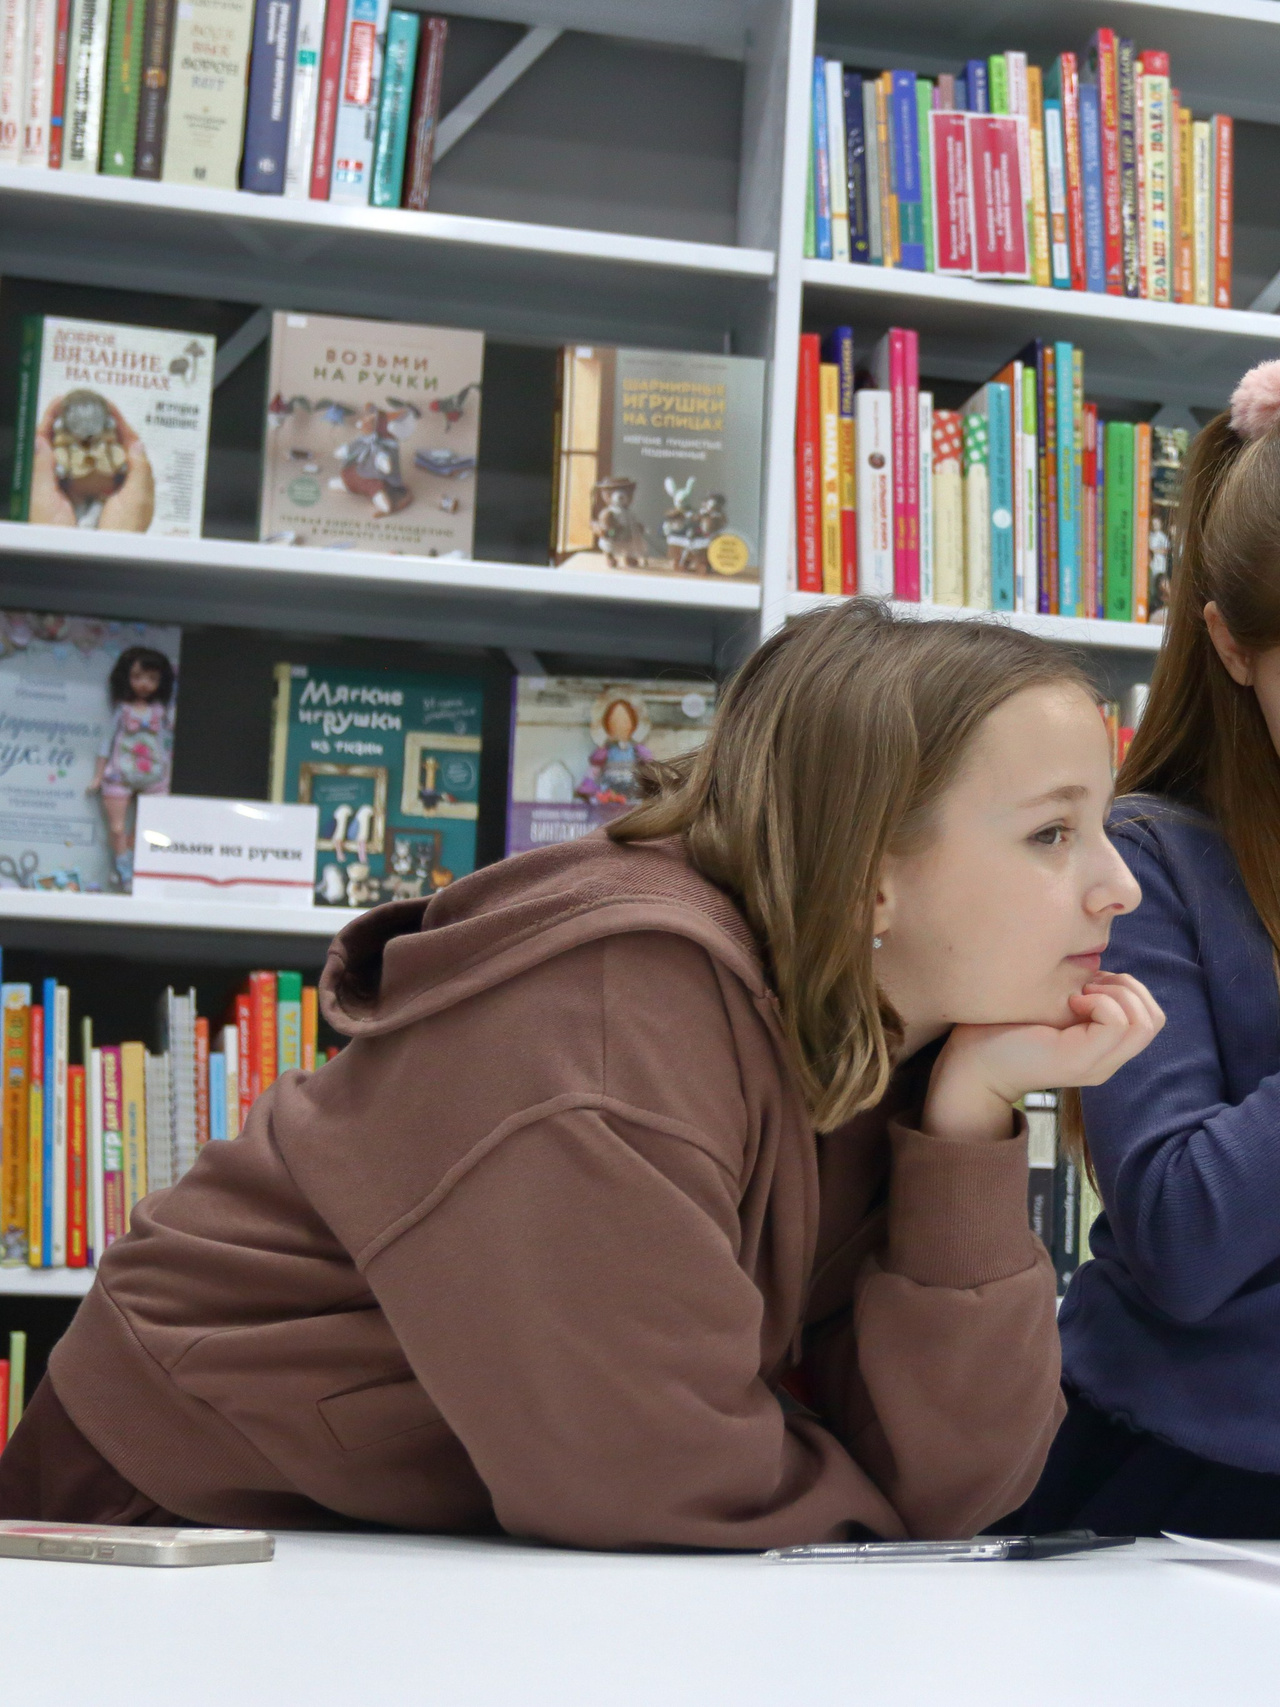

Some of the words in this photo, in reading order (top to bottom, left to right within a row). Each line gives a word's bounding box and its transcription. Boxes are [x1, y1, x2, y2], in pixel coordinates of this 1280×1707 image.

[52, 344, 164, 374] ВЯЗАНИЕ
[325, 348, 430, 372] ВОЗЬМИ
[65, 366, 91, 381] НА
[94, 369, 172, 391] СПИЦАХ
[313, 366, 346, 383] НА
[357, 369, 440, 391] РУЧКИ
[622, 393, 727, 414] ИГРУШКИ
[622, 411, 648, 427] НА
[650, 413, 724, 431] СПИЦАХ
[299, 679, 405, 707] Мягкие
[220, 844, 242, 857] на
[247, 846, 303, 862] ручки
